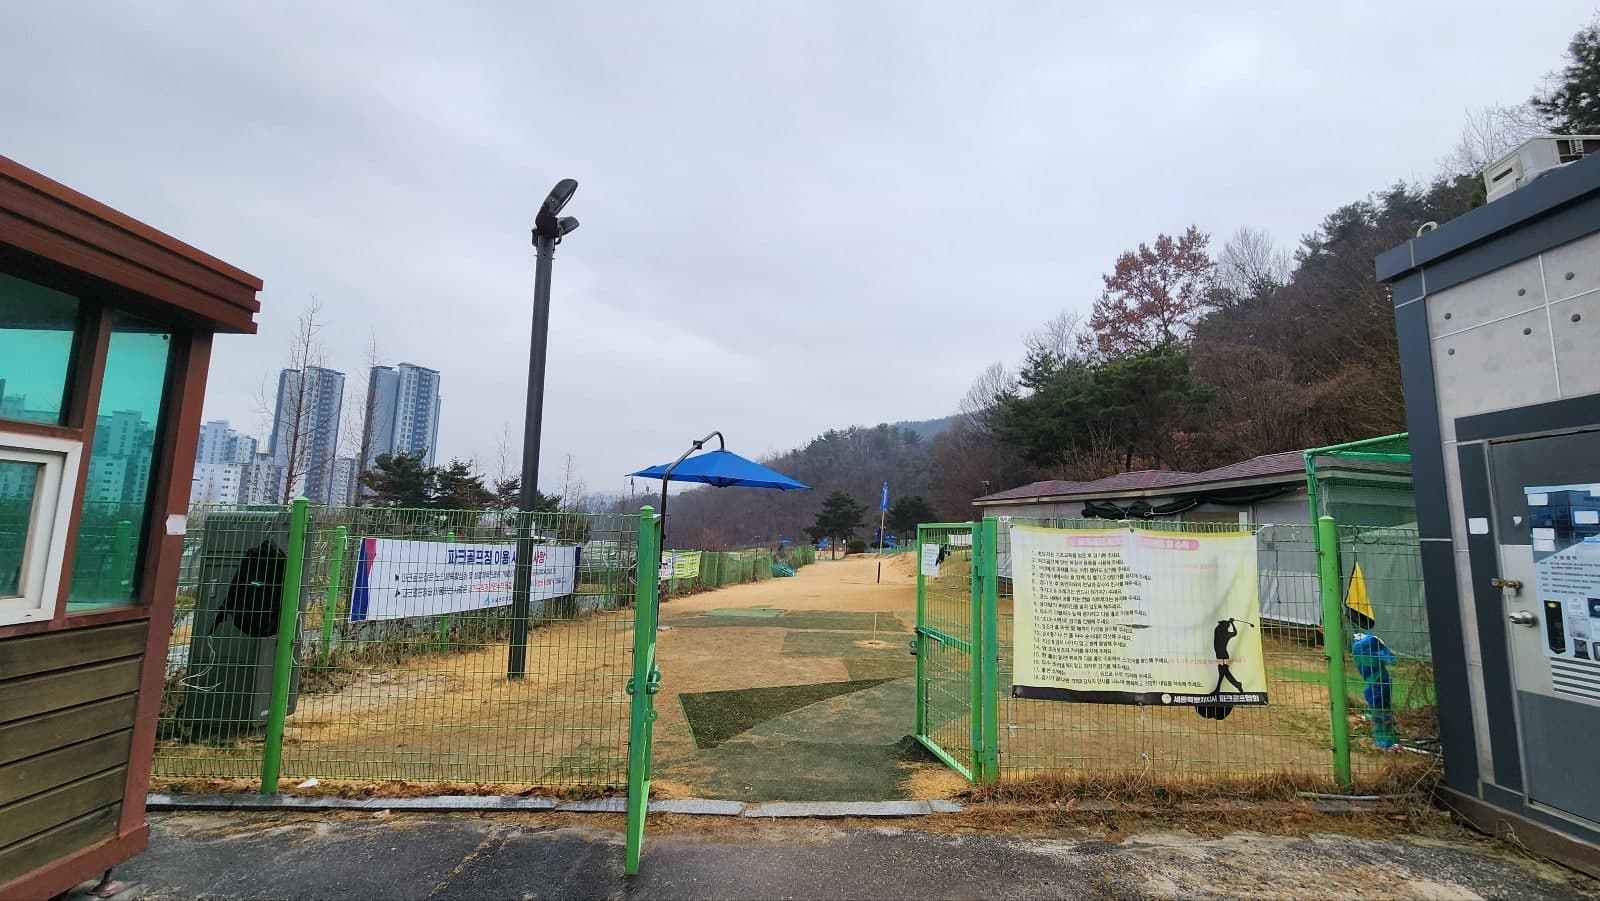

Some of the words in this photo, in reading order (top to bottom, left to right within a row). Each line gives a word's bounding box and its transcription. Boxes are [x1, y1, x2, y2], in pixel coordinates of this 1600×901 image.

[448, 550, 492, 565] 파크골프장
[494, 551, 510, 565] 이용
[1174, 696, 1217, 704] 세종특별자치시
[1220, 694, 1260, 702] 파크골프협회
